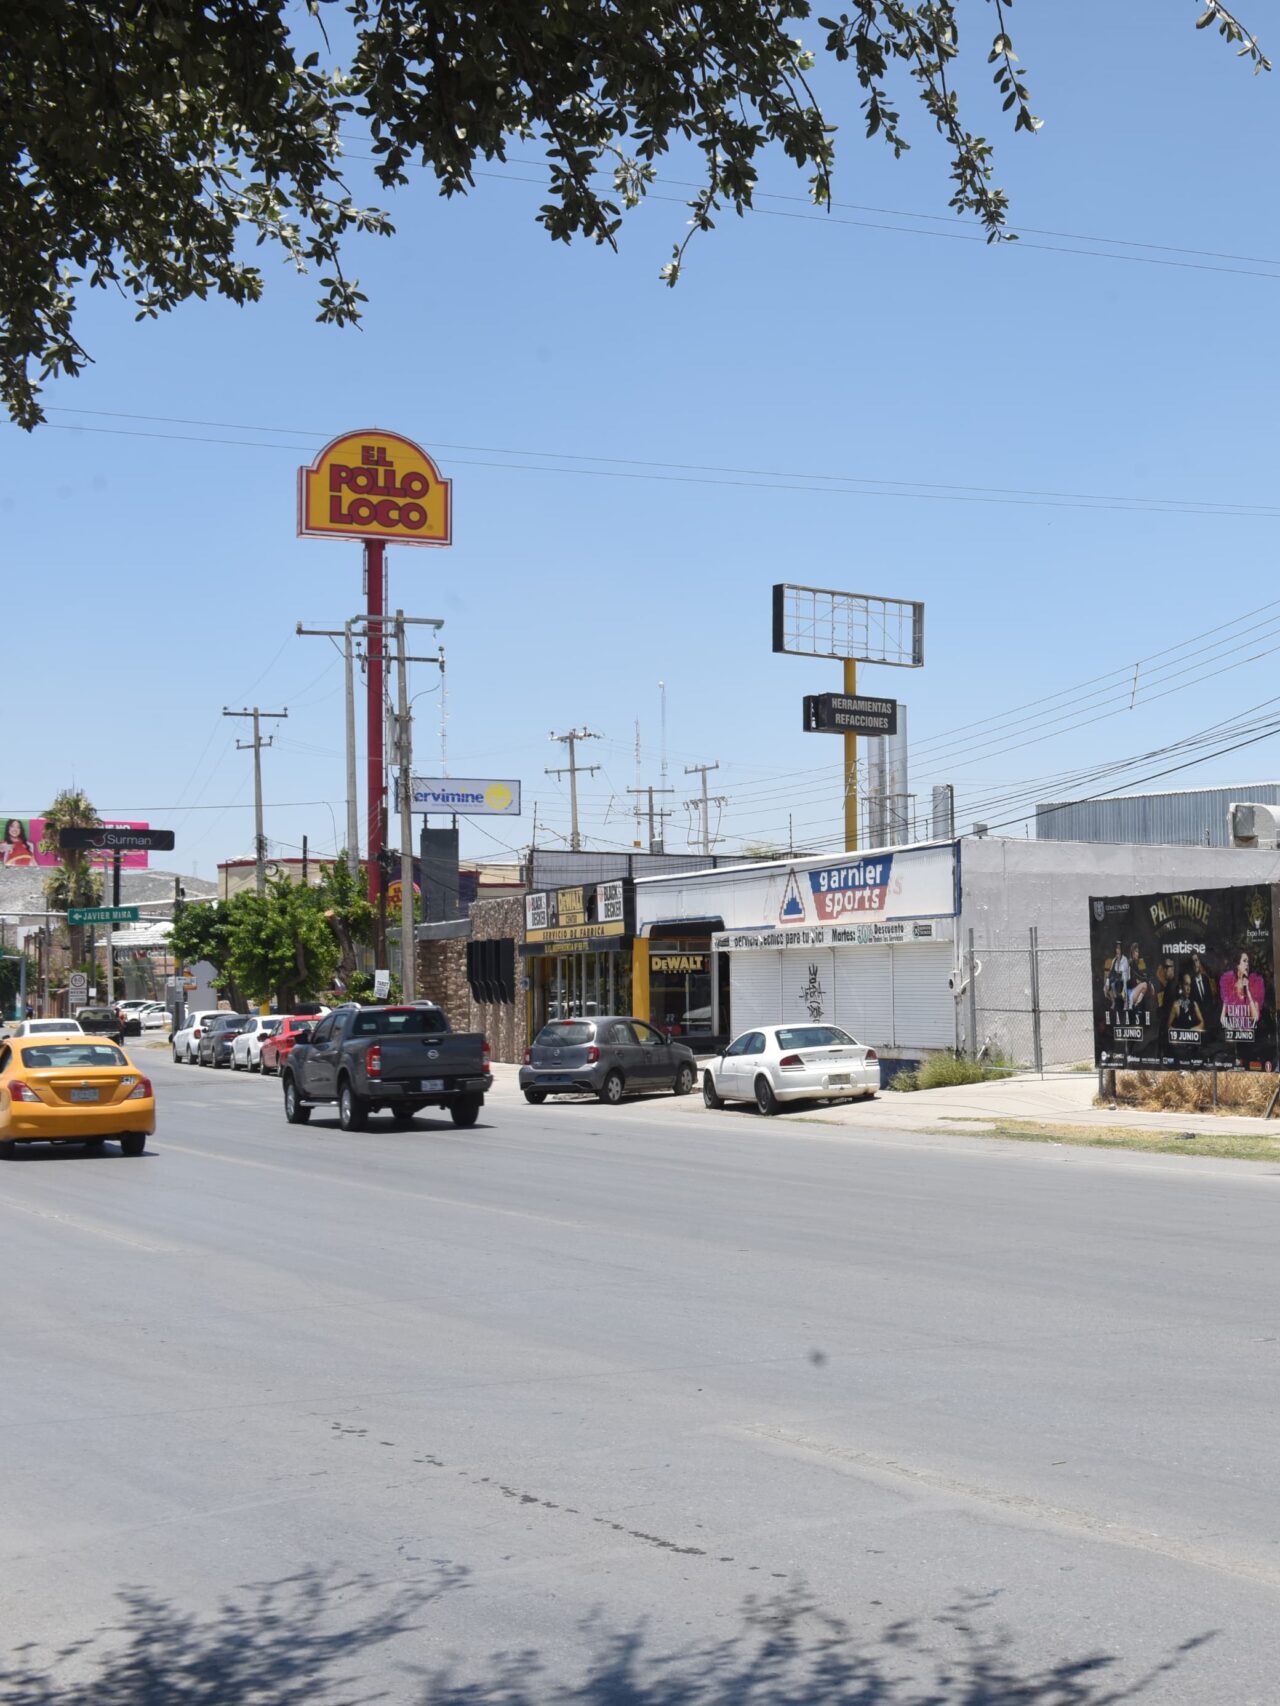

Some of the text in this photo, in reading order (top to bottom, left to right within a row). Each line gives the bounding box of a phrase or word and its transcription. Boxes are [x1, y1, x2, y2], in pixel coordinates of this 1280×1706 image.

[361, 445, 393, 467] EL
[329, 463, 430, 500] POLLO
[329, 494, 428, 530] LOCO
[831, 697, 892, 714] HERRAMIENTAS
[835, 713, 889, 729] REFACCIONES
[107, 834, 151, 845] Surman
[819, 863, 883, 892] garnier
[825, 886, 880, 917] sports
[82, 910, 110, 921] JAVIER
[1149, 895, 1212, 926] PALENQUE
[1162, 940, 1206, 955] matisse
[1115, 1029, 1142, 1039] 13 JUNIO
[1170, 1031, 1199, 1041] 19 JUNIO
[1235, 1029, 1254, 1040] JUNIO
